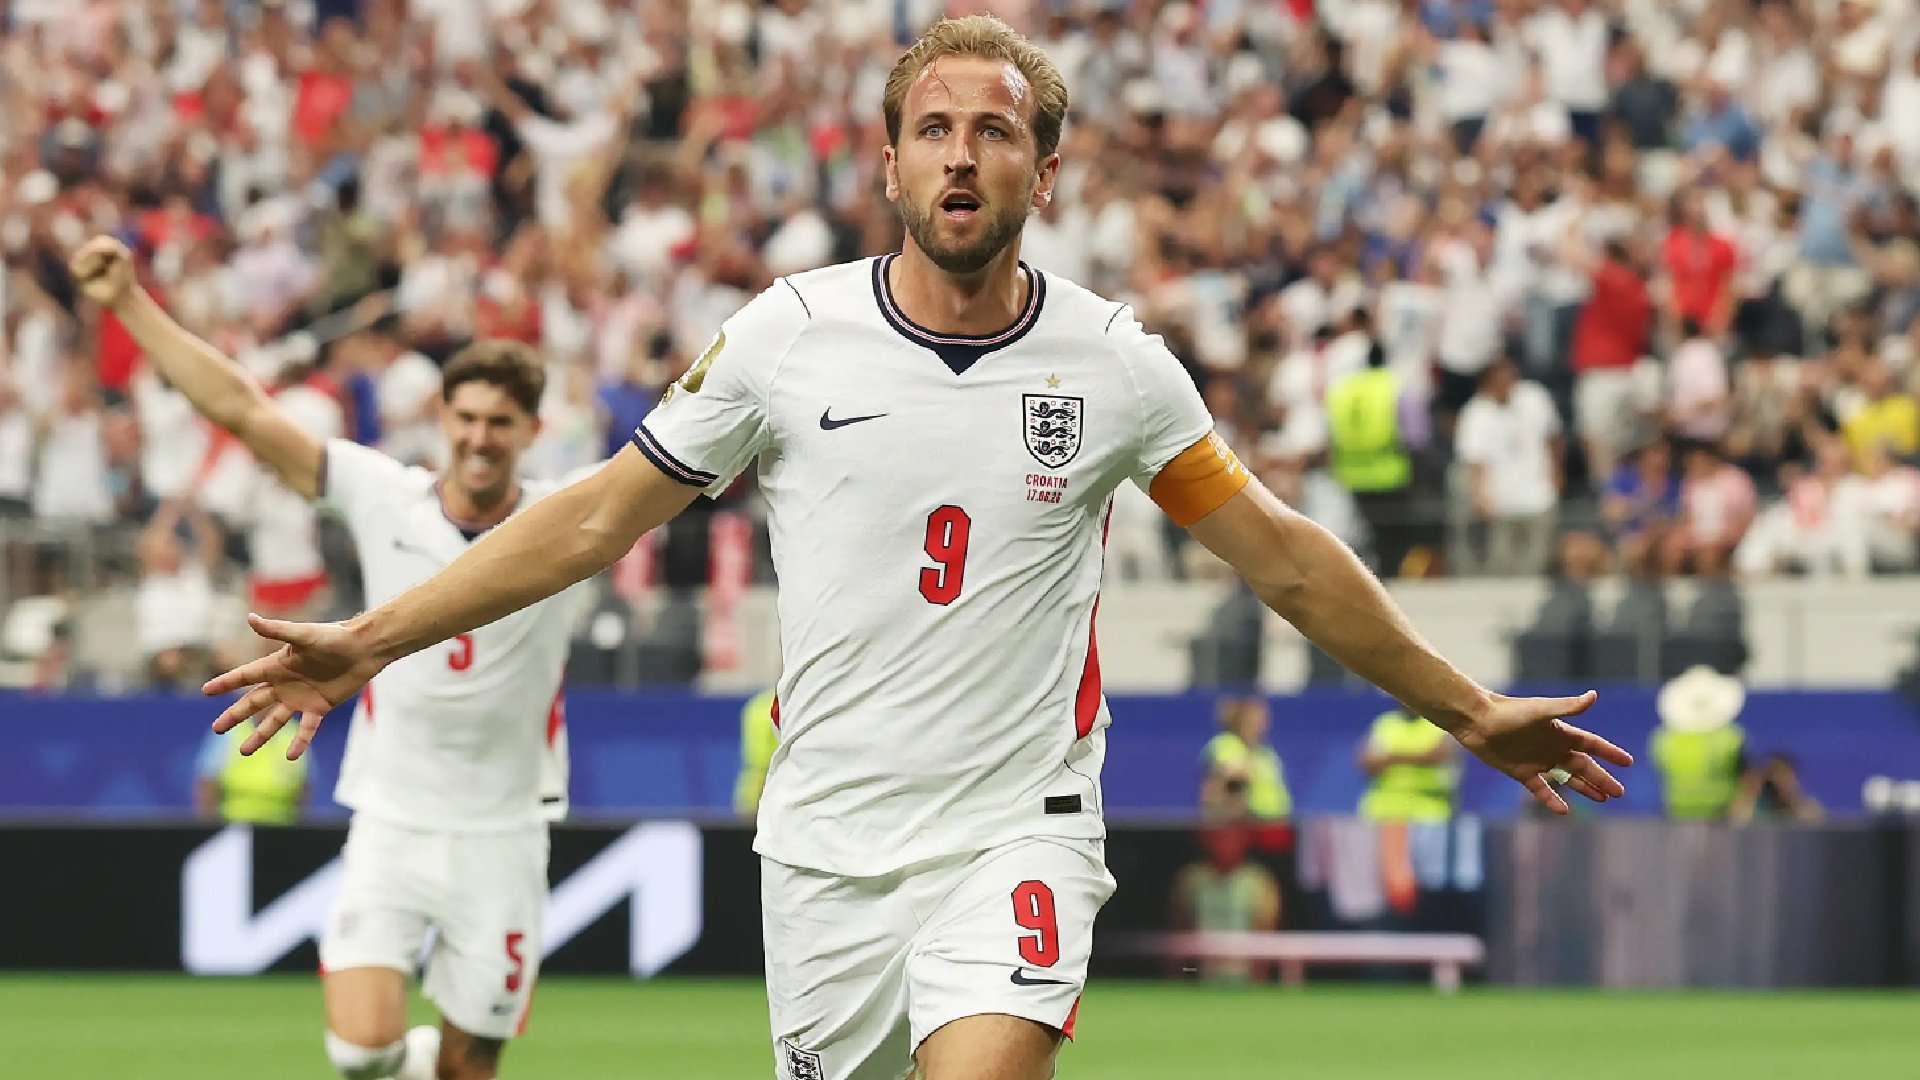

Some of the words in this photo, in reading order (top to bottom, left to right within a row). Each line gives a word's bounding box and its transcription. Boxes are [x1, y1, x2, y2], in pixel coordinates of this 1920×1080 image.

[1025, 474, 1068, 489] CROATIA
[919, 505, 971, 605] 9
[1011, 879, 1060, 968] 9
[504, 931, 524, 993] 5
